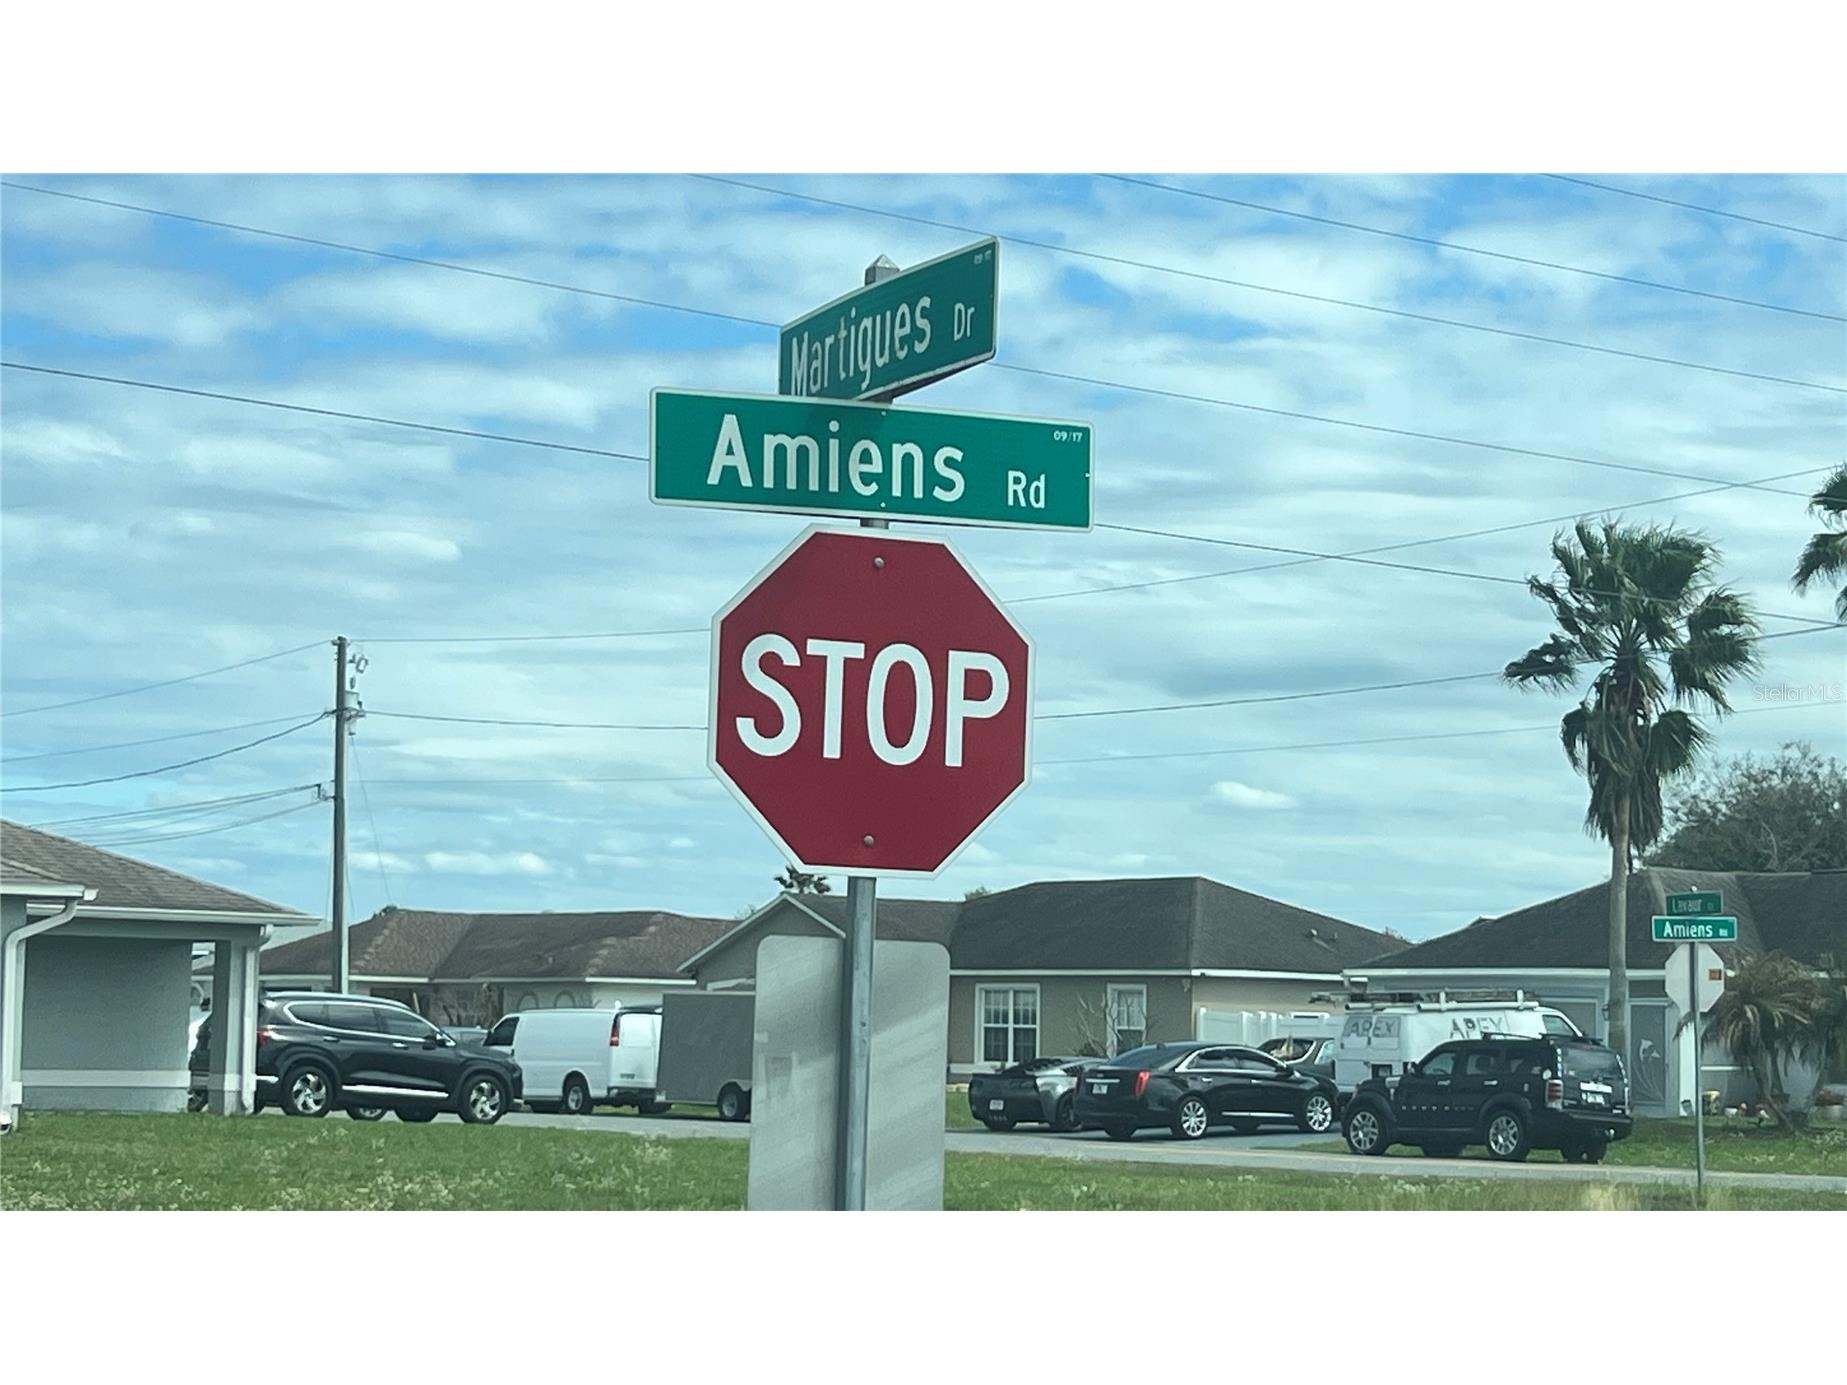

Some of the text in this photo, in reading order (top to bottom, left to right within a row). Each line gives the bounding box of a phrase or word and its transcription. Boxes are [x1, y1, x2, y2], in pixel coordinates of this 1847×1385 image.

[790, 296, 975, 396] Martigues Dr
[706, 413, 1046, 509] Amiens Rd
[1053, 430, 1083, 442] 09/17
[735, 633, 1010, 767] STOP
[1663, 920, 1713, 937] Amiens
